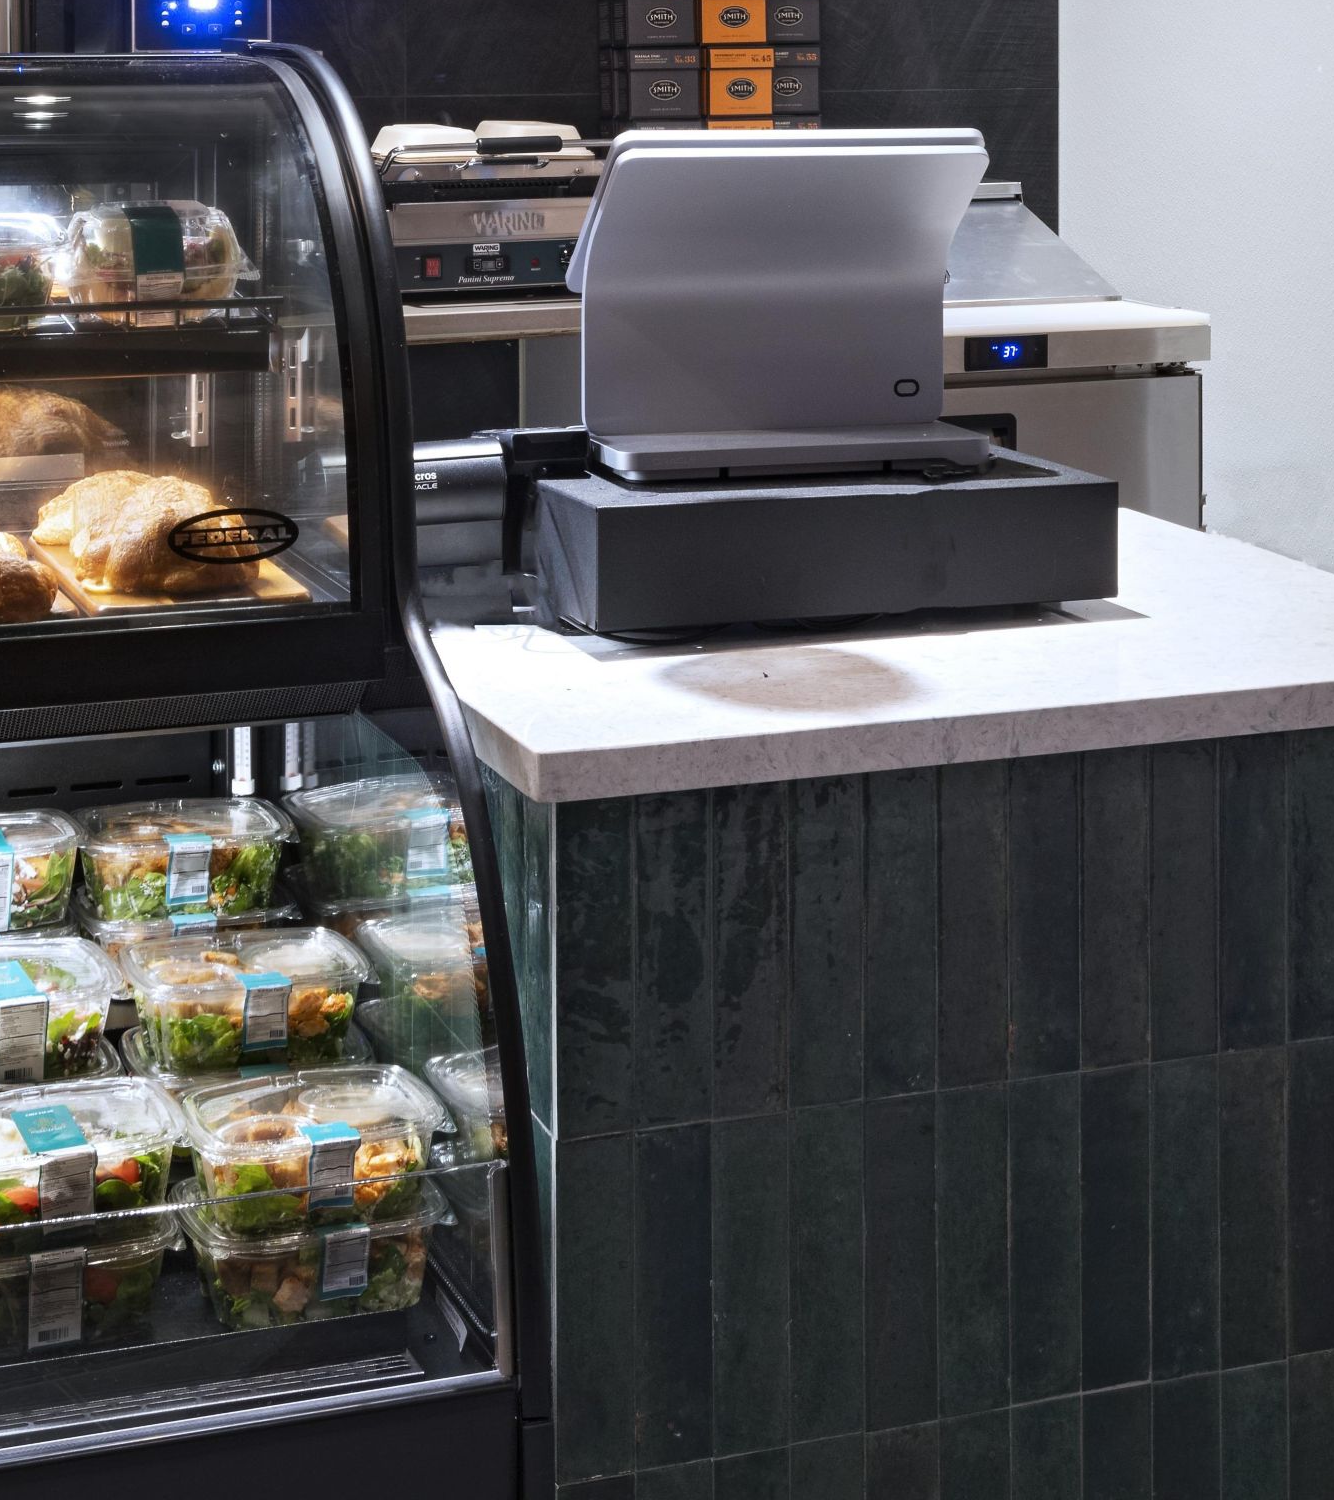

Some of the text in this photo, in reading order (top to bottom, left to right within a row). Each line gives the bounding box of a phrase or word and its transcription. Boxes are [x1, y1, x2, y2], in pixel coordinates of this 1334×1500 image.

[650, 13, 674, 21] SMITH
[723, 12, 746, 20] SMITH
[731, 84, 753, 92] SMITH
[474, 244, 499, 252] WARING
[458, 275, 482, 284] Panini
[414, 482, 438, 491] ACLE
[174, 524, 292, 548] FEDERAL
